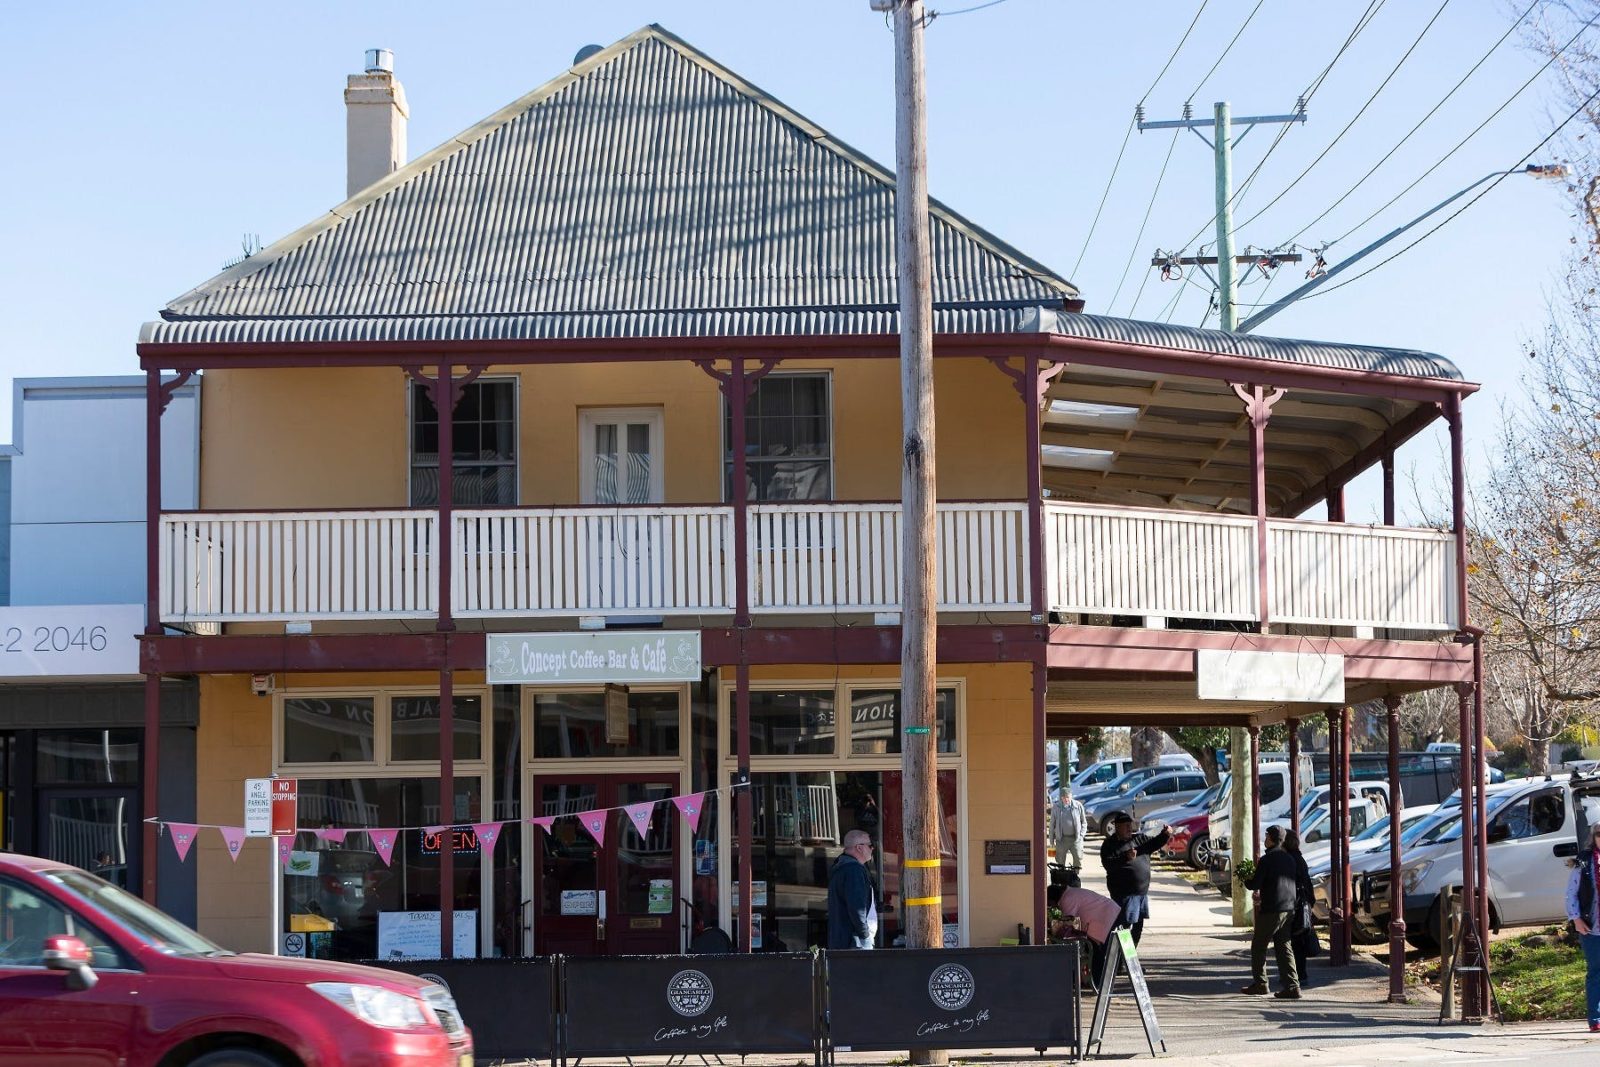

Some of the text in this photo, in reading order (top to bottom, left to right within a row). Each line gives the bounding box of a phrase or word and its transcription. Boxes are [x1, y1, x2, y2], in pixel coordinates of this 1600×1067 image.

[33, 625, 107, 652] 2046
[521, 637, 667, 676] Concept Coffee Bar & Café
[280, 782, 289, 791] NO
[247, 799, 269, 807] PARKING
[654, 1027, 688, 1041] Coffee
[697, 1025, 711, 1038] my
[916, 1021, 951, 1036] Coffee
[960, 1019, 974, 1032] my
